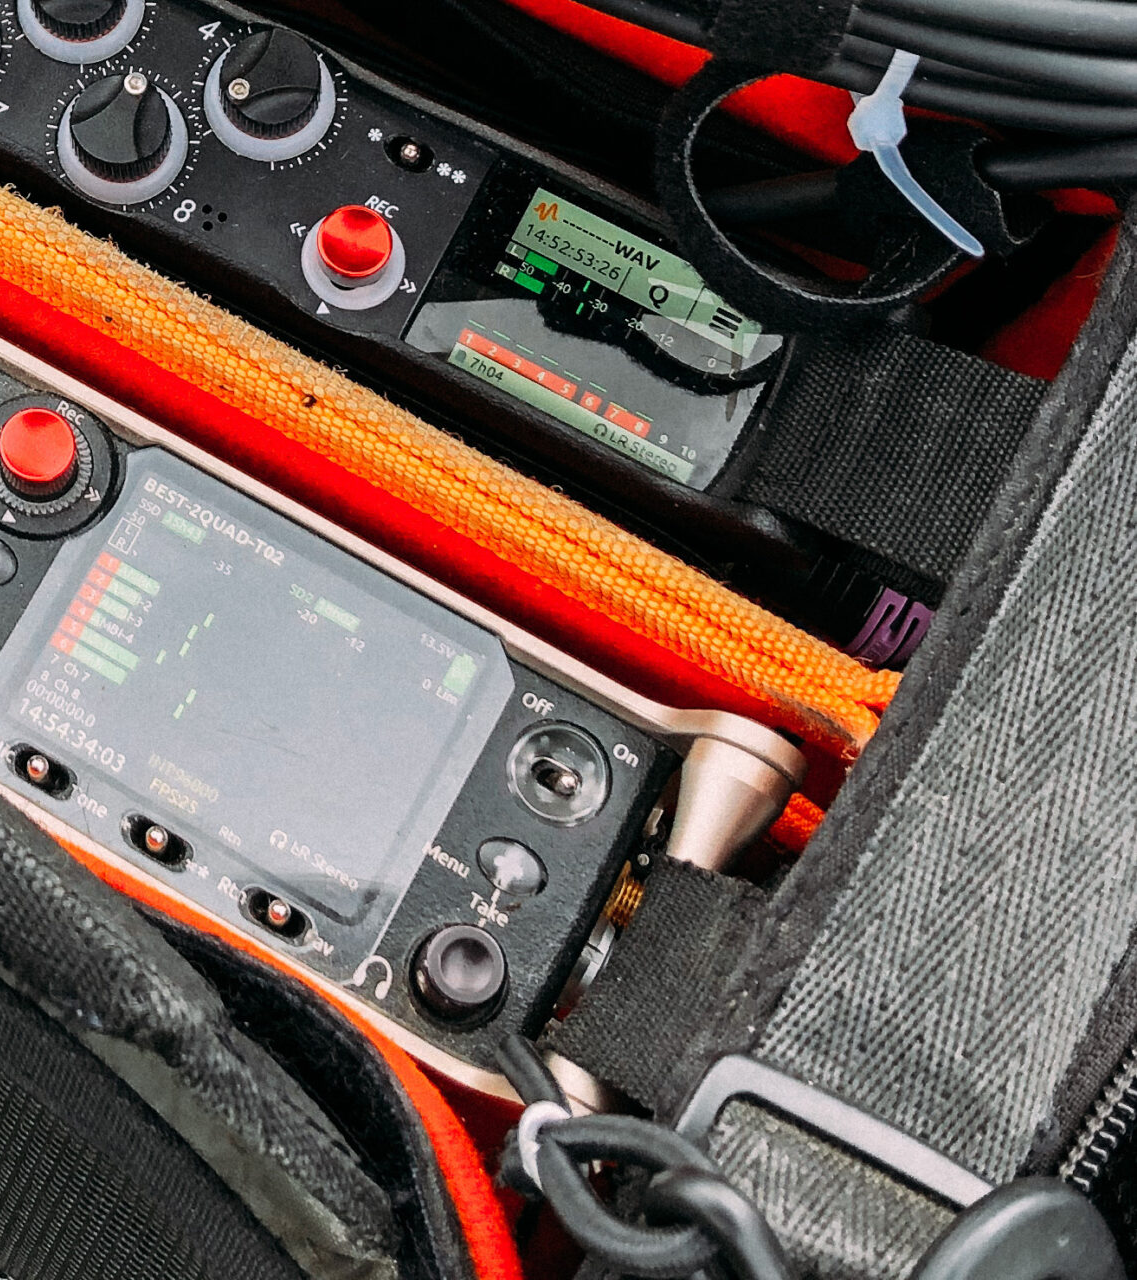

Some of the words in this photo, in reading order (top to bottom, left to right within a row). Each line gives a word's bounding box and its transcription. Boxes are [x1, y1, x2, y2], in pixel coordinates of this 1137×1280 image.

[198, 21, 222, 41] 4
[173, 198, 197, 223] 8
[364, 194, 399, 220] REC
[525, 223, 622, 281] 14:52:53:26
[469, 356, 504, 382] 7h04
[707, 357, 717, 368] 0
[56, 400, 85, 426] Rec
[487, 346, 498, 357] 2
[560, 383, 571, 394] 5
[585, 396, 594, 407] 6
[608, 408, 619, 419] 7
[634, 421, 644, 433] 8
[659, 434, 668, 445] 9
[681, 445, 697, 460] 10
[143, 477, 285, 567] BEST-2QUAD-T02
[213, 560, 233, 576] -35
[297, 609, 318, 624] -20
[64, 661, 79, 678] Ch
[54, 678, 70, 694] Ch
[522, 692, 555, 717] Off
[18, 698, 127, 773] 14:54:34:03
[613, 743, 639, 767] On
[422, 841, 471, 879] Menu
[470, 890, 510, 927] Take
